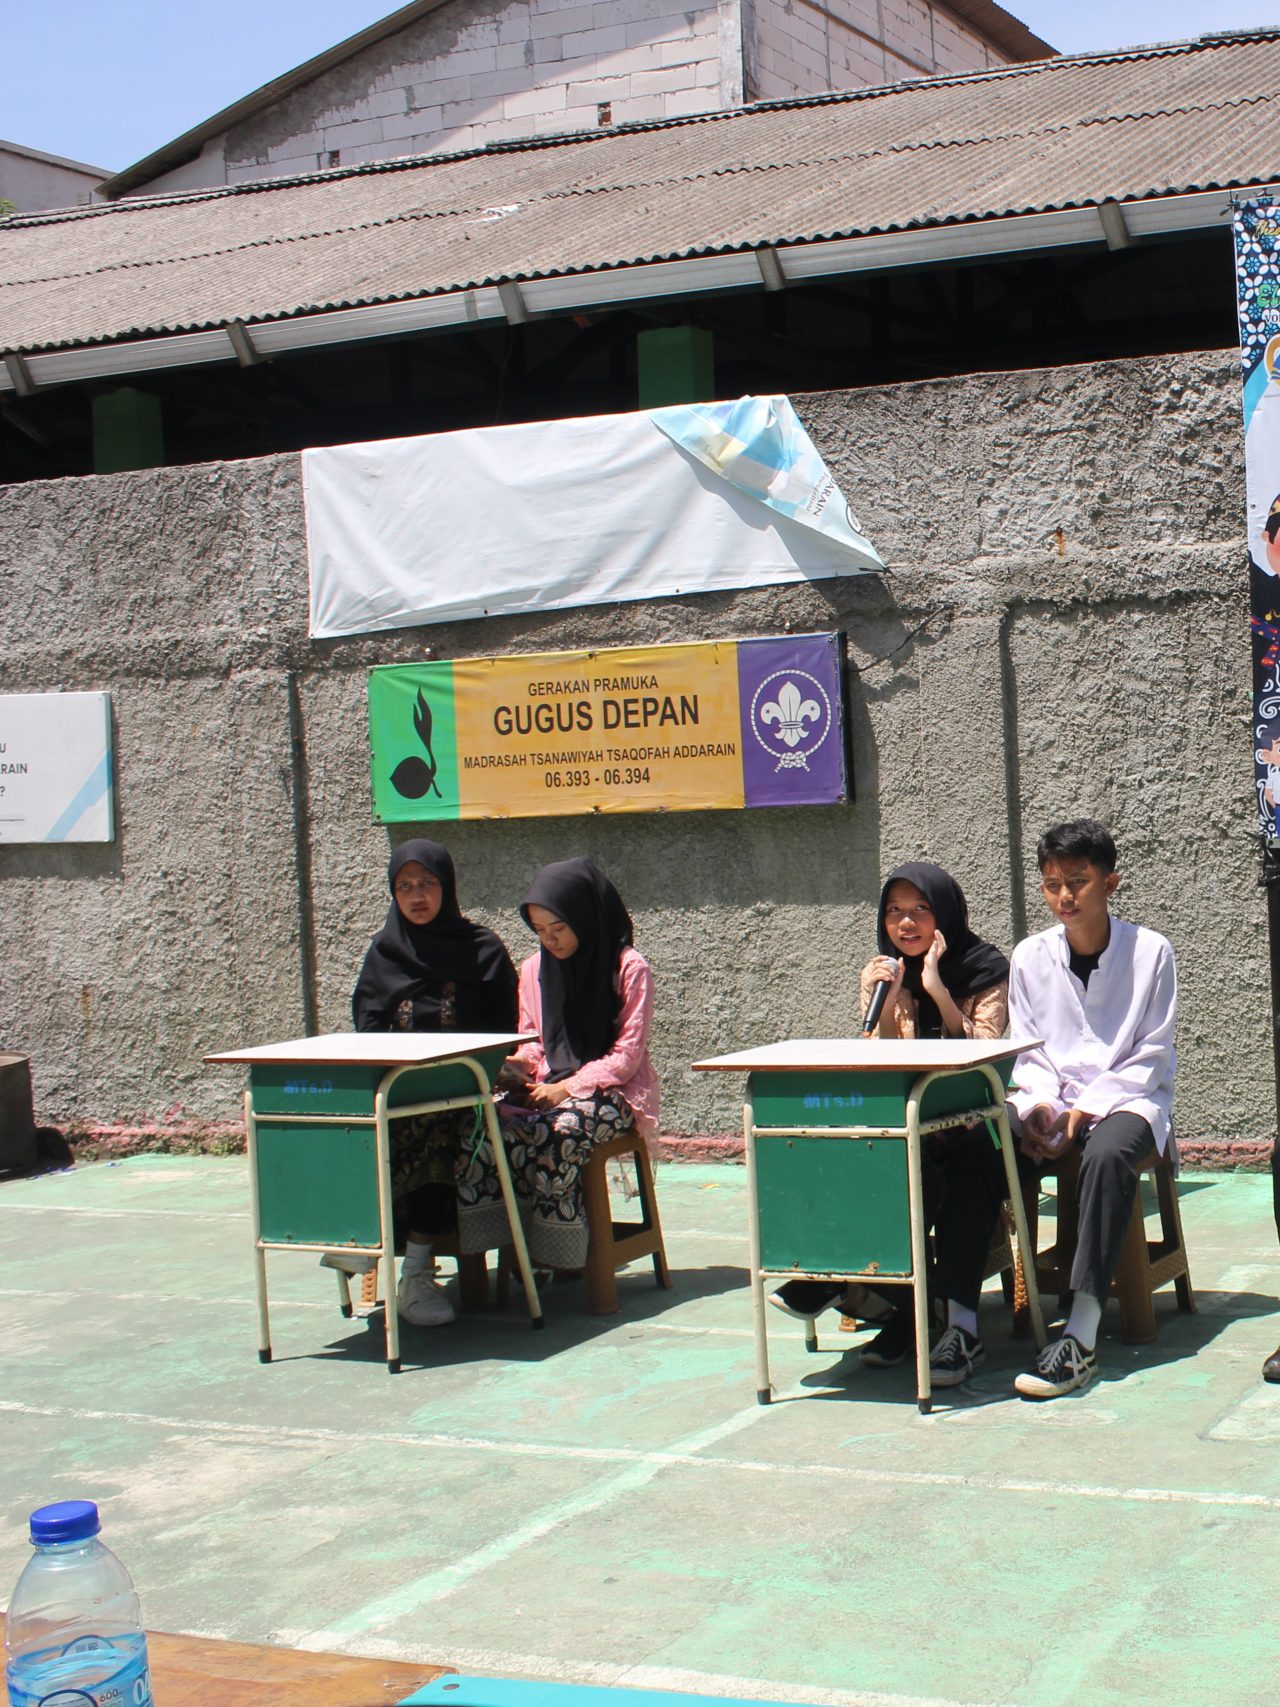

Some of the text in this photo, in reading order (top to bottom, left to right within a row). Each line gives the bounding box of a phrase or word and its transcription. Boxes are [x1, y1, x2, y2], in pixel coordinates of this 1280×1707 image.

[528, 675, 659, 697] GERAKAN PRAMUKA
[493, 694, 700, 736] GUGUS DEPAN
[463, 743, 736, 769] MADRASAH TSANAWIYAH TSAQOFAH ADDARAIN
[0, 763, 28, 774] RAIN
[545, 770, 592, 789] 06.393
[603, 767, 651, 786] 06.394
